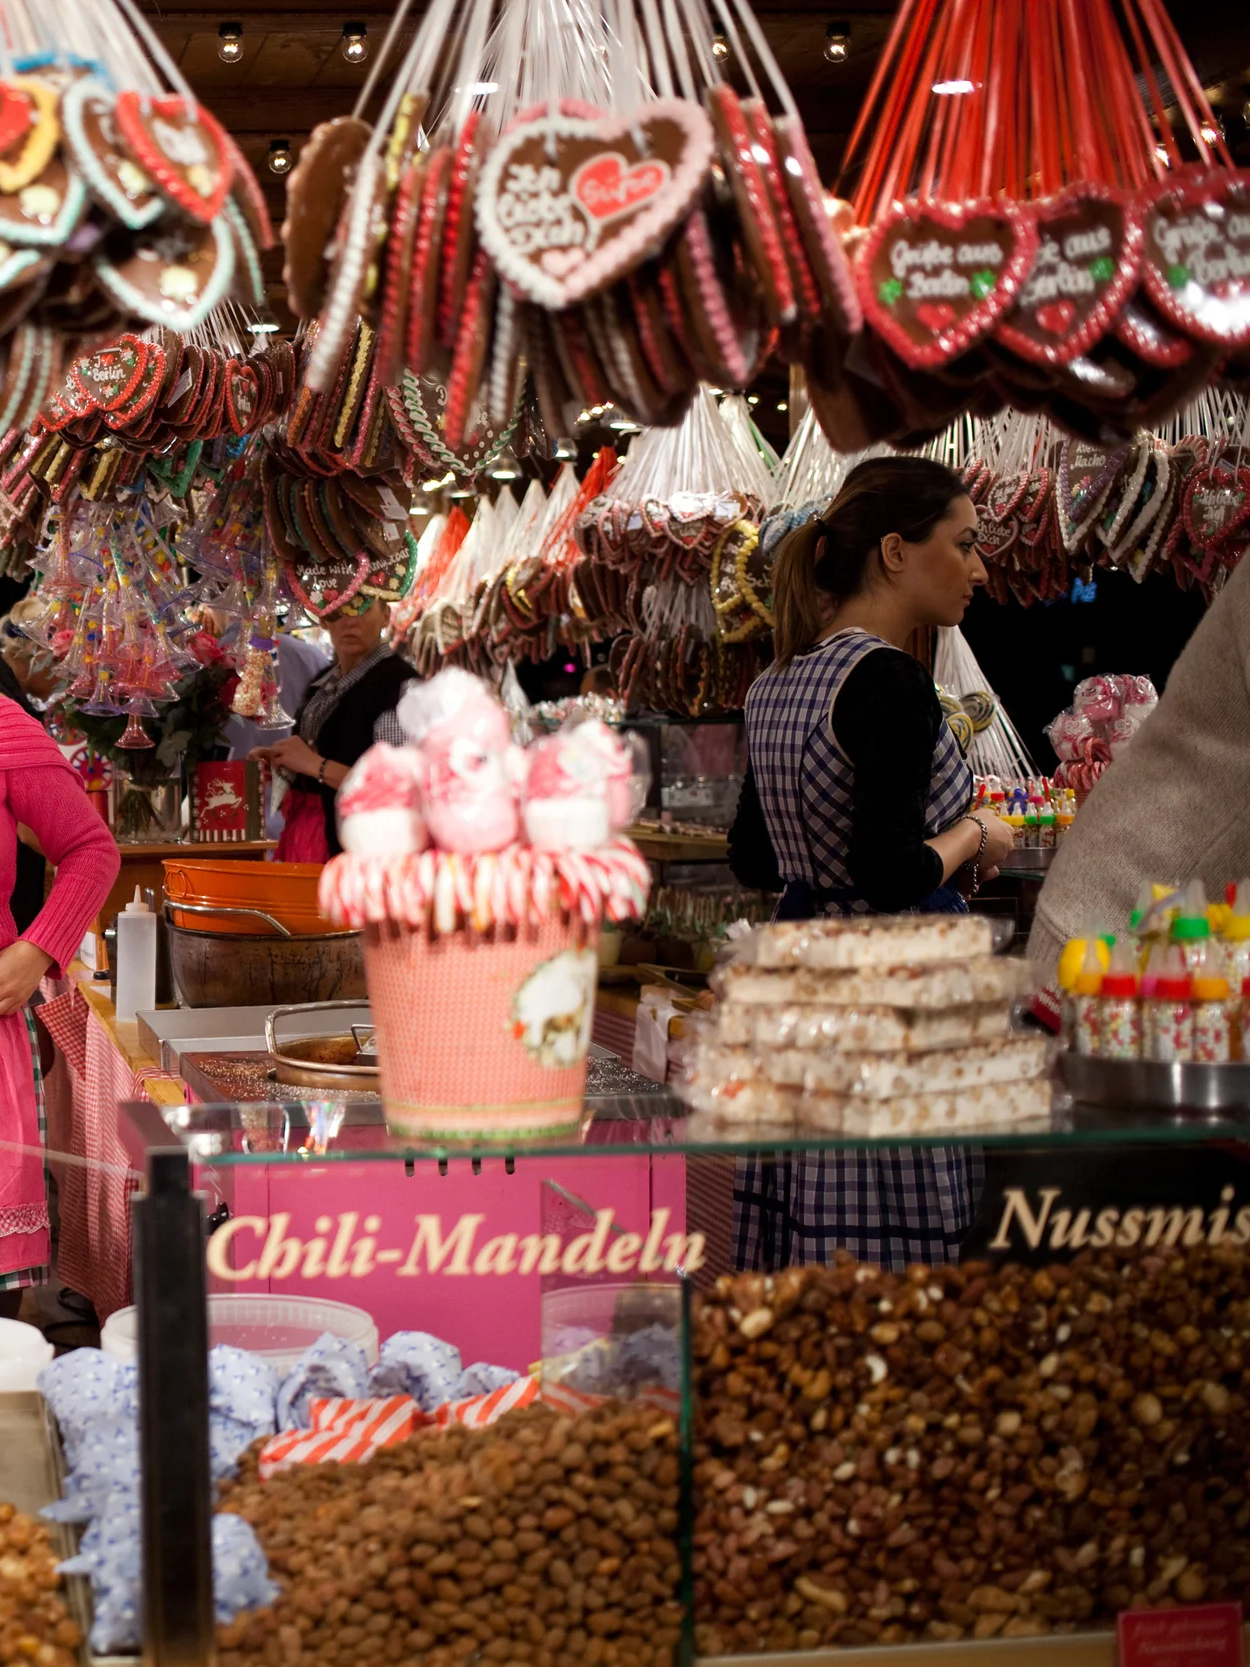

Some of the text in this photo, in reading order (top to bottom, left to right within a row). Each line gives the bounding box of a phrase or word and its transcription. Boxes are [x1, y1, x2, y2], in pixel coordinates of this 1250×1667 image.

[92, 366, 127, 382] Berlin
[296, 564, 327, 577] Made
[328, 560, 355, 576] with
[314, 576, 338, 590] Love
[205, 1207, 708, 1281] Chili-Mandeln
